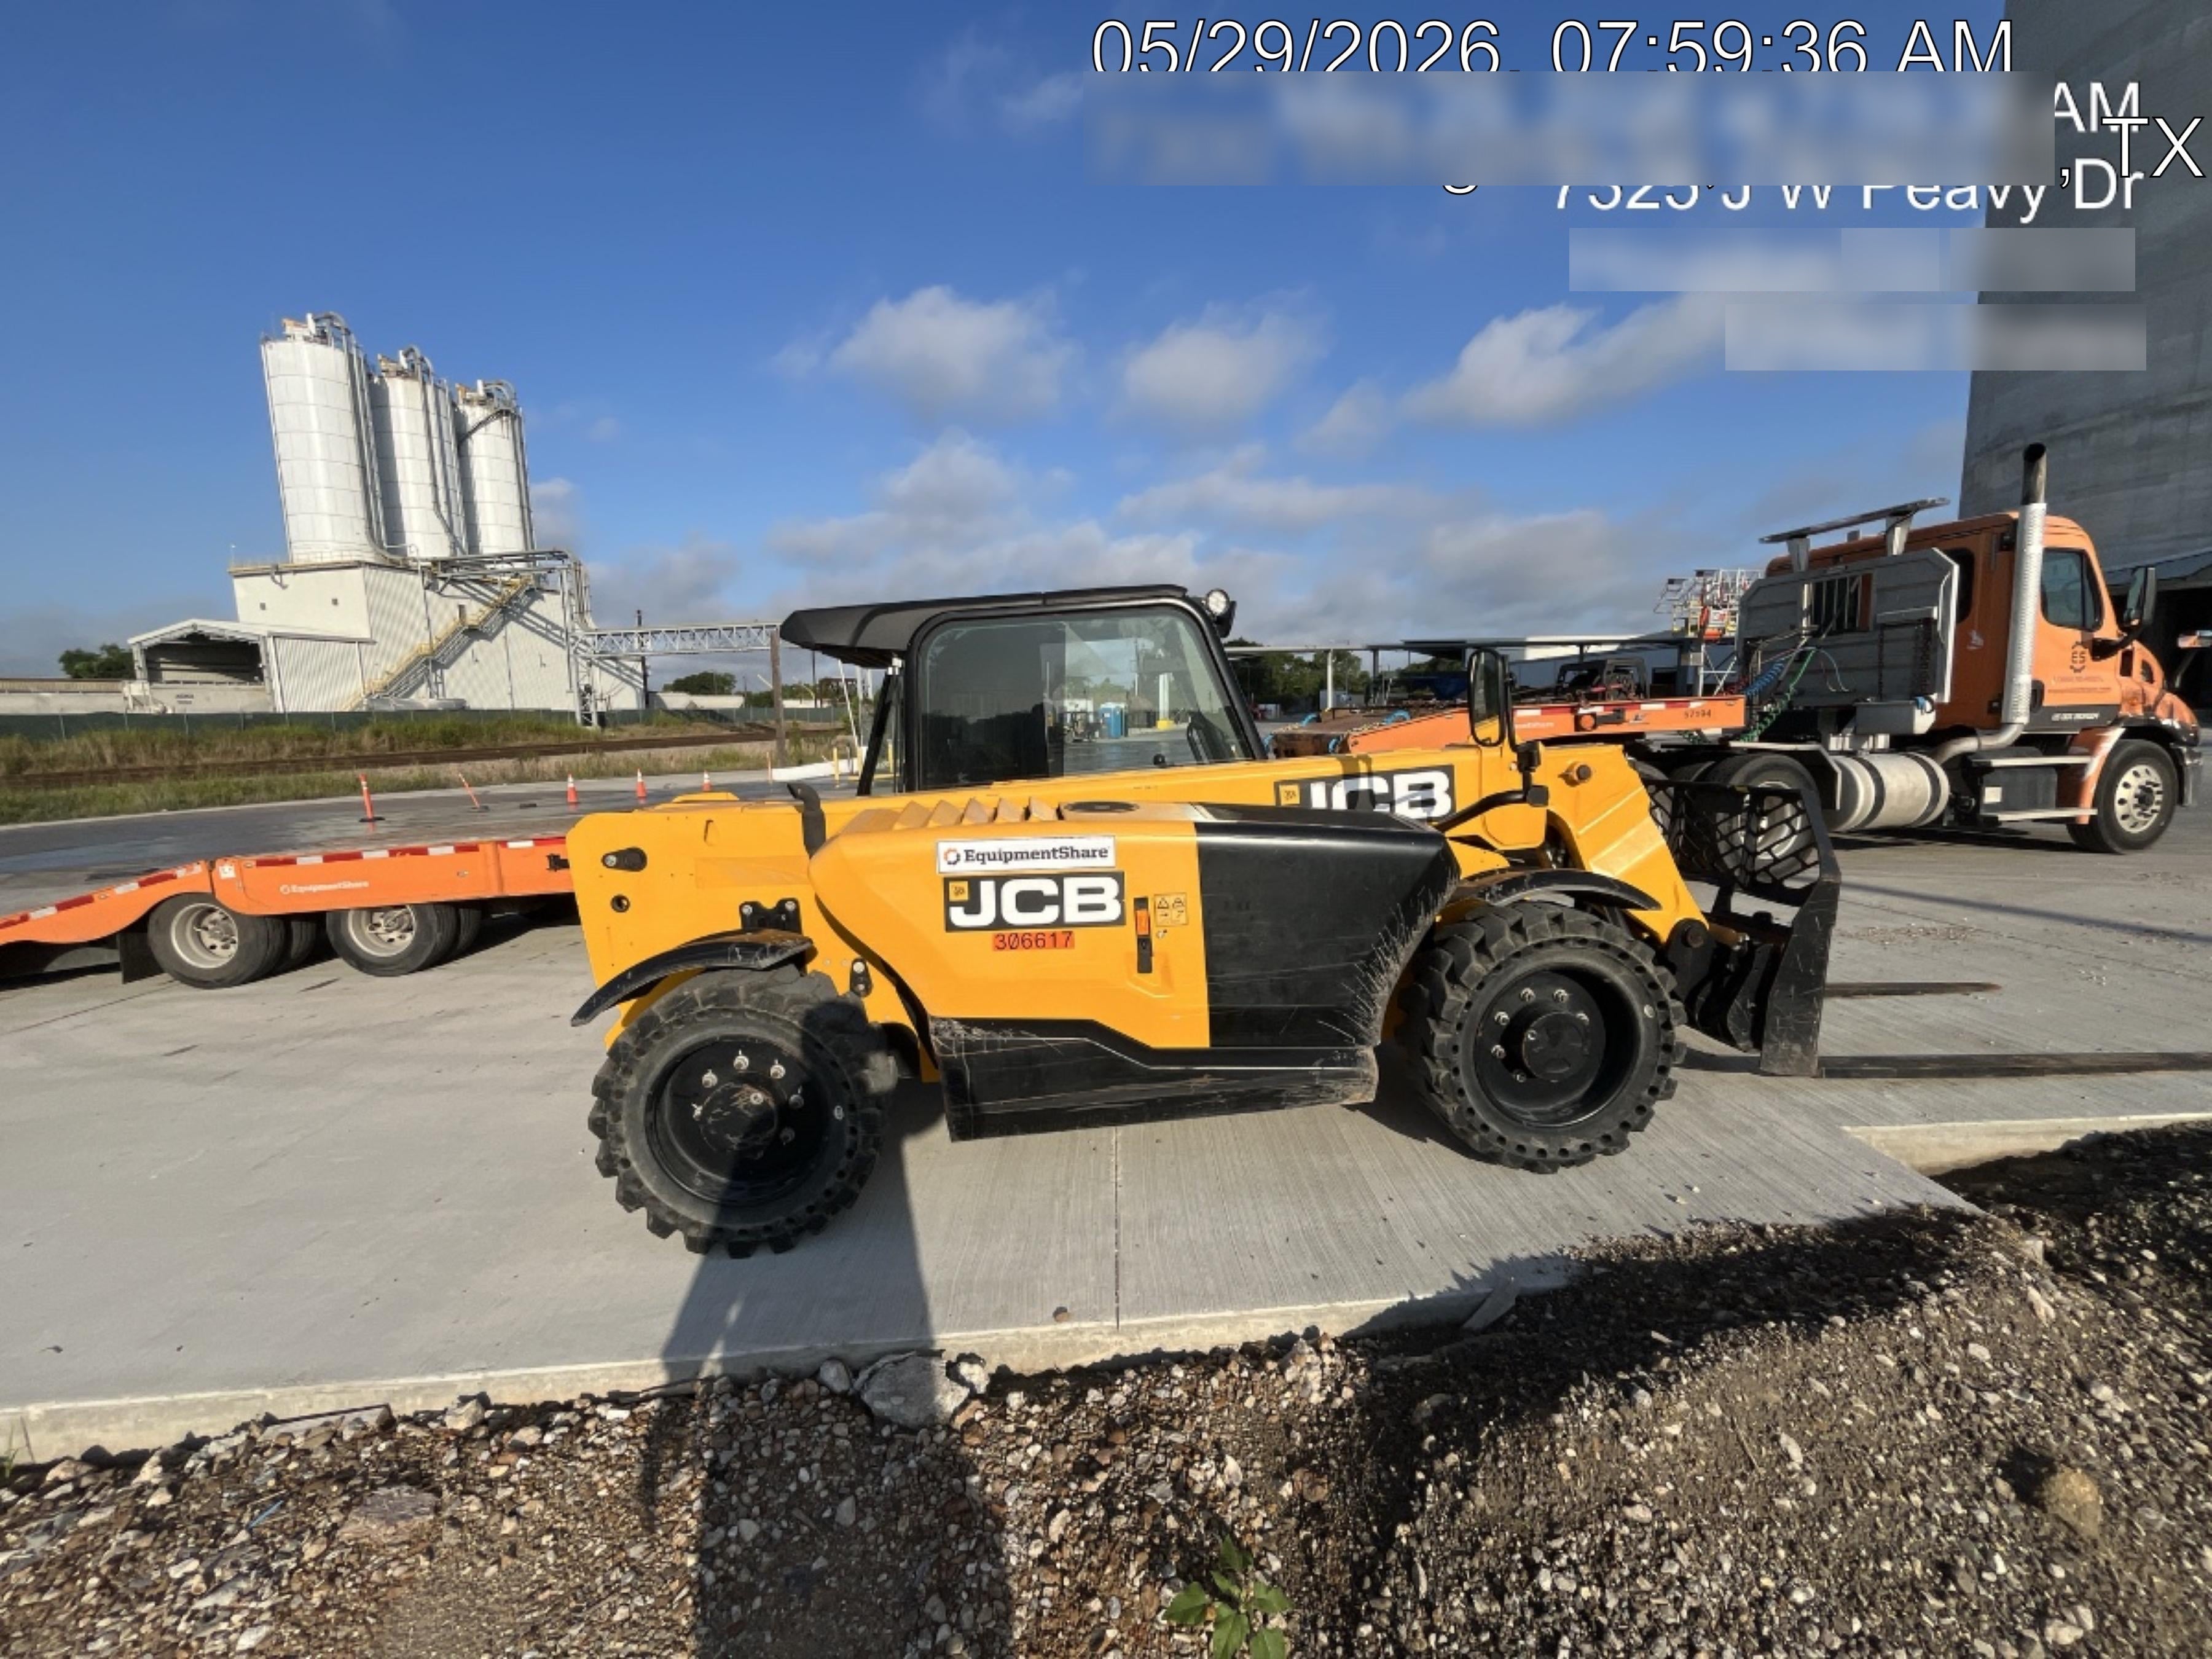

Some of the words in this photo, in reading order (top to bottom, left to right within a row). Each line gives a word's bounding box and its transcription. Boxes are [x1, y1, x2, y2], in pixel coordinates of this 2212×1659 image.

[963, 845, 1108, 864] EquipmentShare
[949, 877, 1121, 927] JCB
[995, 930, 1073, 950] 306617
